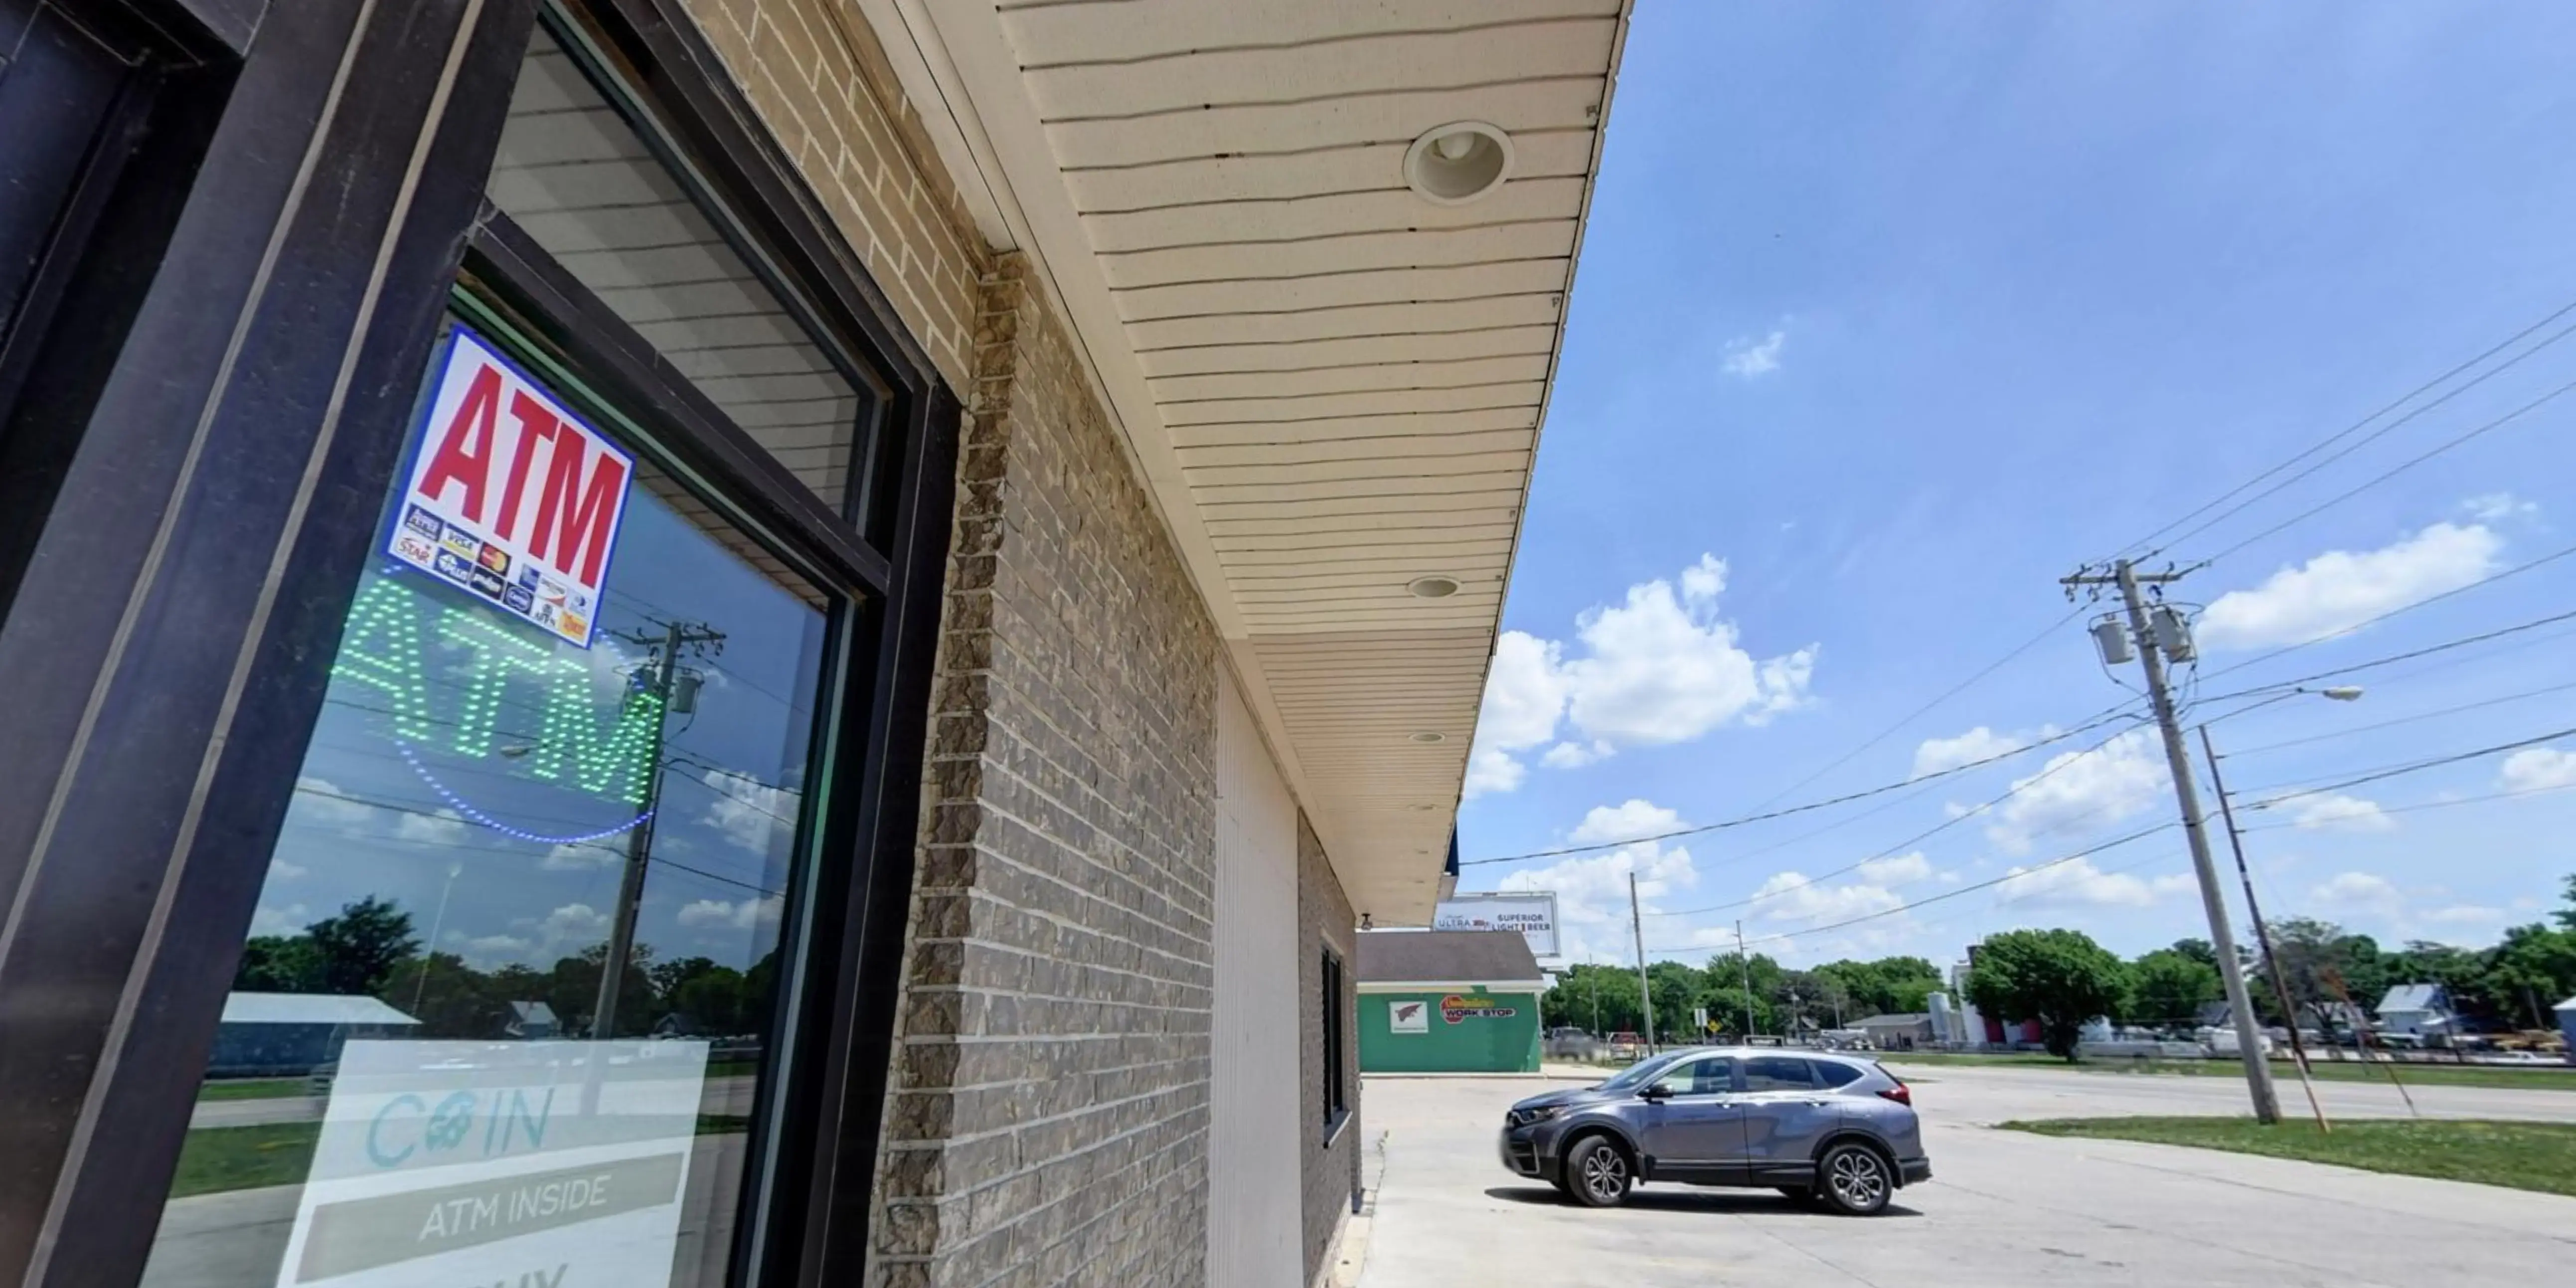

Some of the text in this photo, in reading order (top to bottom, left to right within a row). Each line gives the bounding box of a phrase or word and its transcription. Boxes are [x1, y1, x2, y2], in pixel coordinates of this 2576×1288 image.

[417, 362, 626, 589] ATM
[400, 539, 430, 563] STAR
[330, 579, 662, 805] ATM
[417, 1175, 612, 1242] ATM INSIDE
